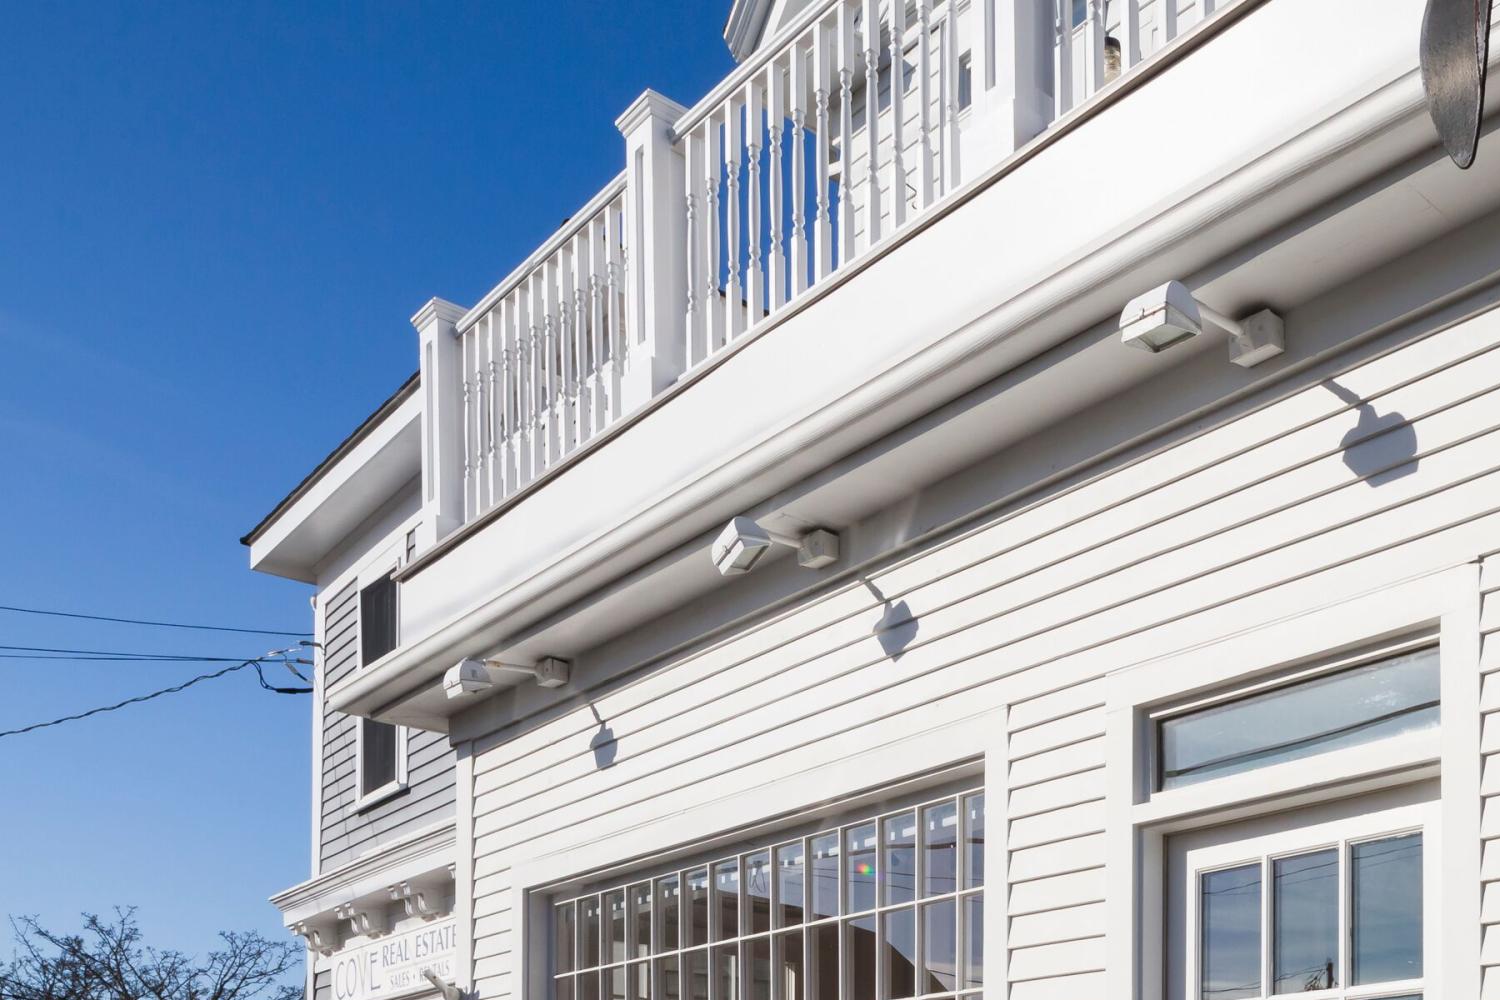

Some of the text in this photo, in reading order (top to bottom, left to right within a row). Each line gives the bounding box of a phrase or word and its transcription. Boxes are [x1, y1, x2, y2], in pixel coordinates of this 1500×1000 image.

[336, 924, 456, 1000] COVE REAL ESTATE
